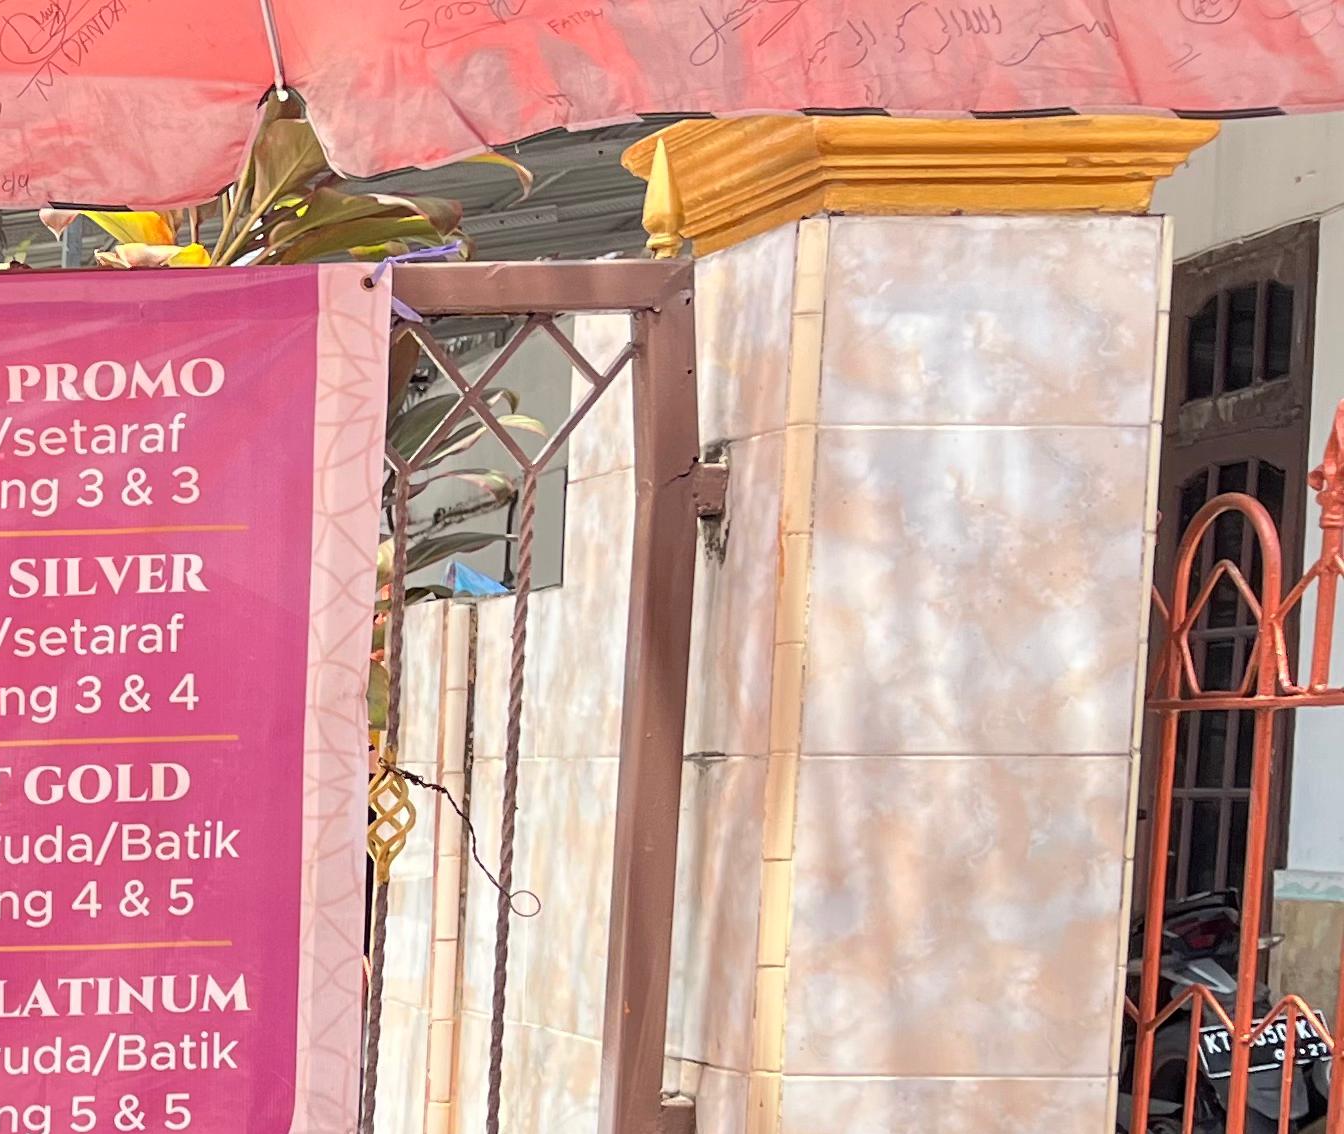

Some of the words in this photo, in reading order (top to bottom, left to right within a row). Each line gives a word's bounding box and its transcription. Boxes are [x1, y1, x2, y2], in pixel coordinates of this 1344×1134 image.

[5, 357, 226, 404] PROMO
[75, 469, 105, 509] 3
[120, 470, 153, 506] &
[172, 465, 201, 505] 3
[8, 553, 210, 599] SILVER
[75, 676, 103, 715] 3
[119, 678, 152, 713] &
[168, 673, 200, 712] 4
[23, 762, 192, 806] GOLD
[71, 881, 103, 918] 4
[117, 881, 150, 917] &
[167, 878, 194, 915] 5
[69, 1095, 97, 1132] 5
[112, 1094, 146, 1130] &
[164, 1092, 192, 1130] 5
